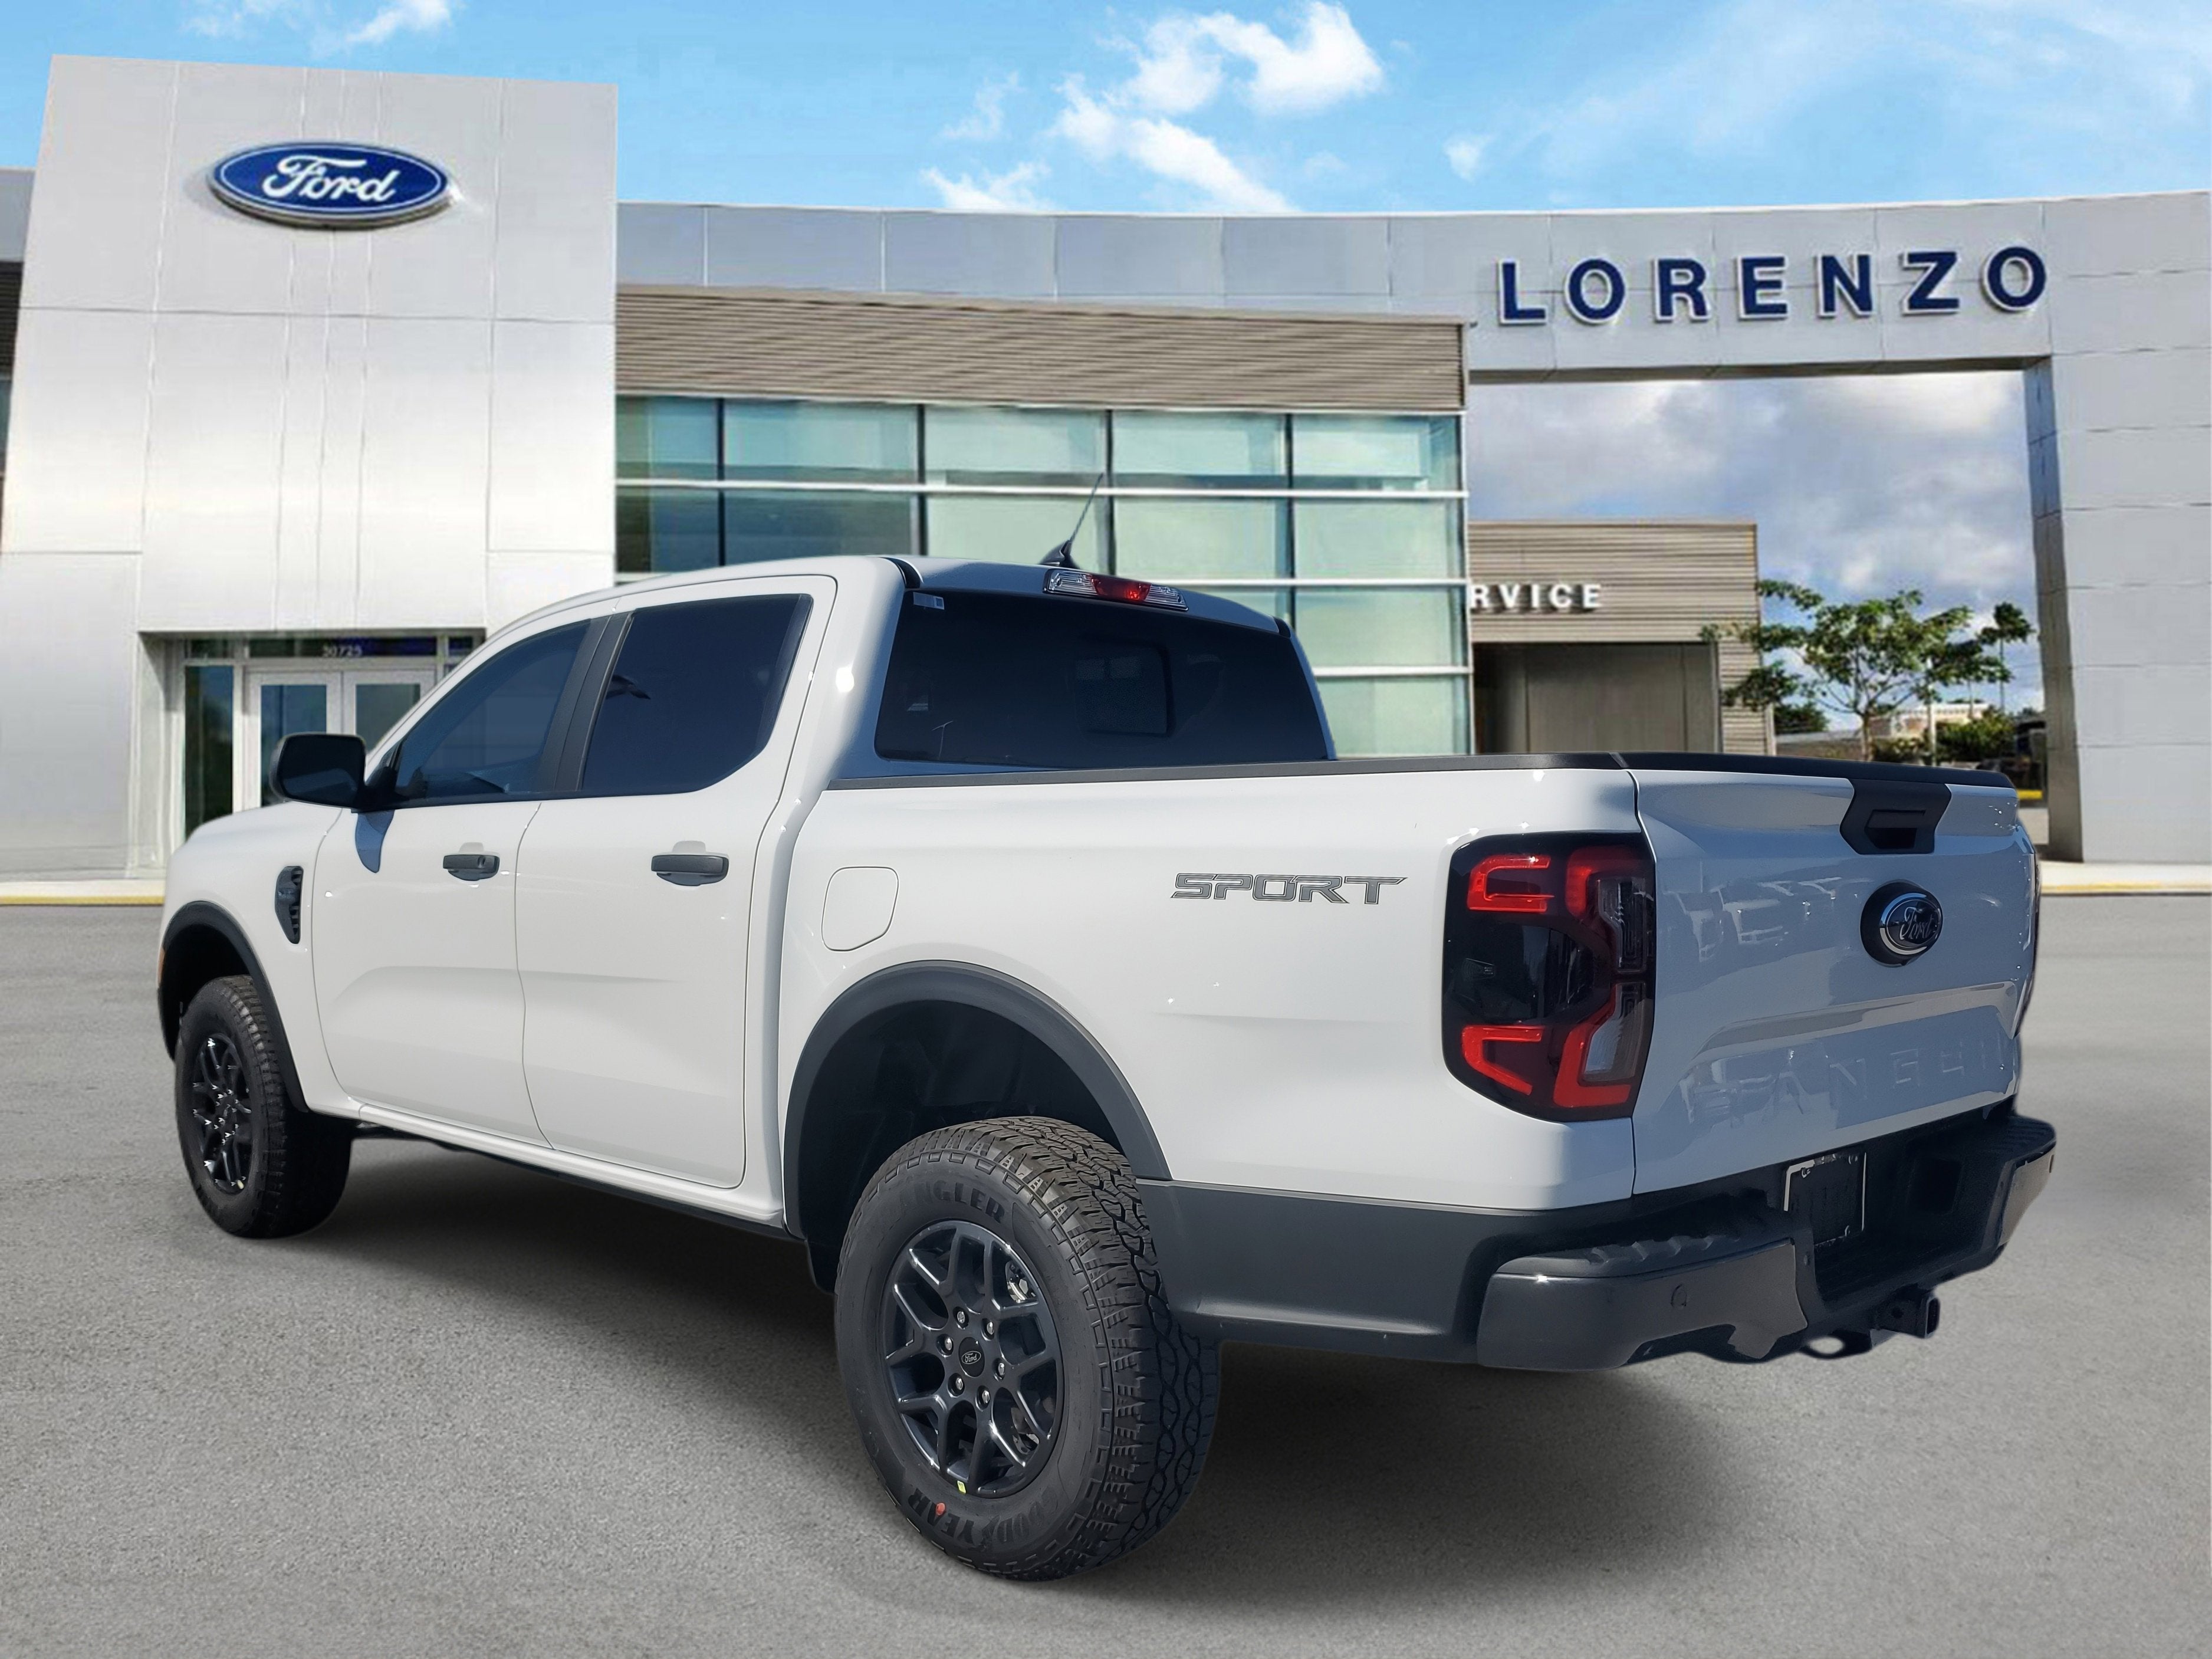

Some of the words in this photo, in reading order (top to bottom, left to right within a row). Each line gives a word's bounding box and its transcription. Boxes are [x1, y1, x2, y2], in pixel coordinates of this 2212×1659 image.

[262, 155, 400, 202] Ford
[1498, 246, 2047, 323] LORENZO
[1471, 583, 1602, 609] RVICE
[1171, 873, 1408, 904] SPORT
[1899, 906, 1934, 940] Ford
[965, 1353, 977, 1363] Ford
